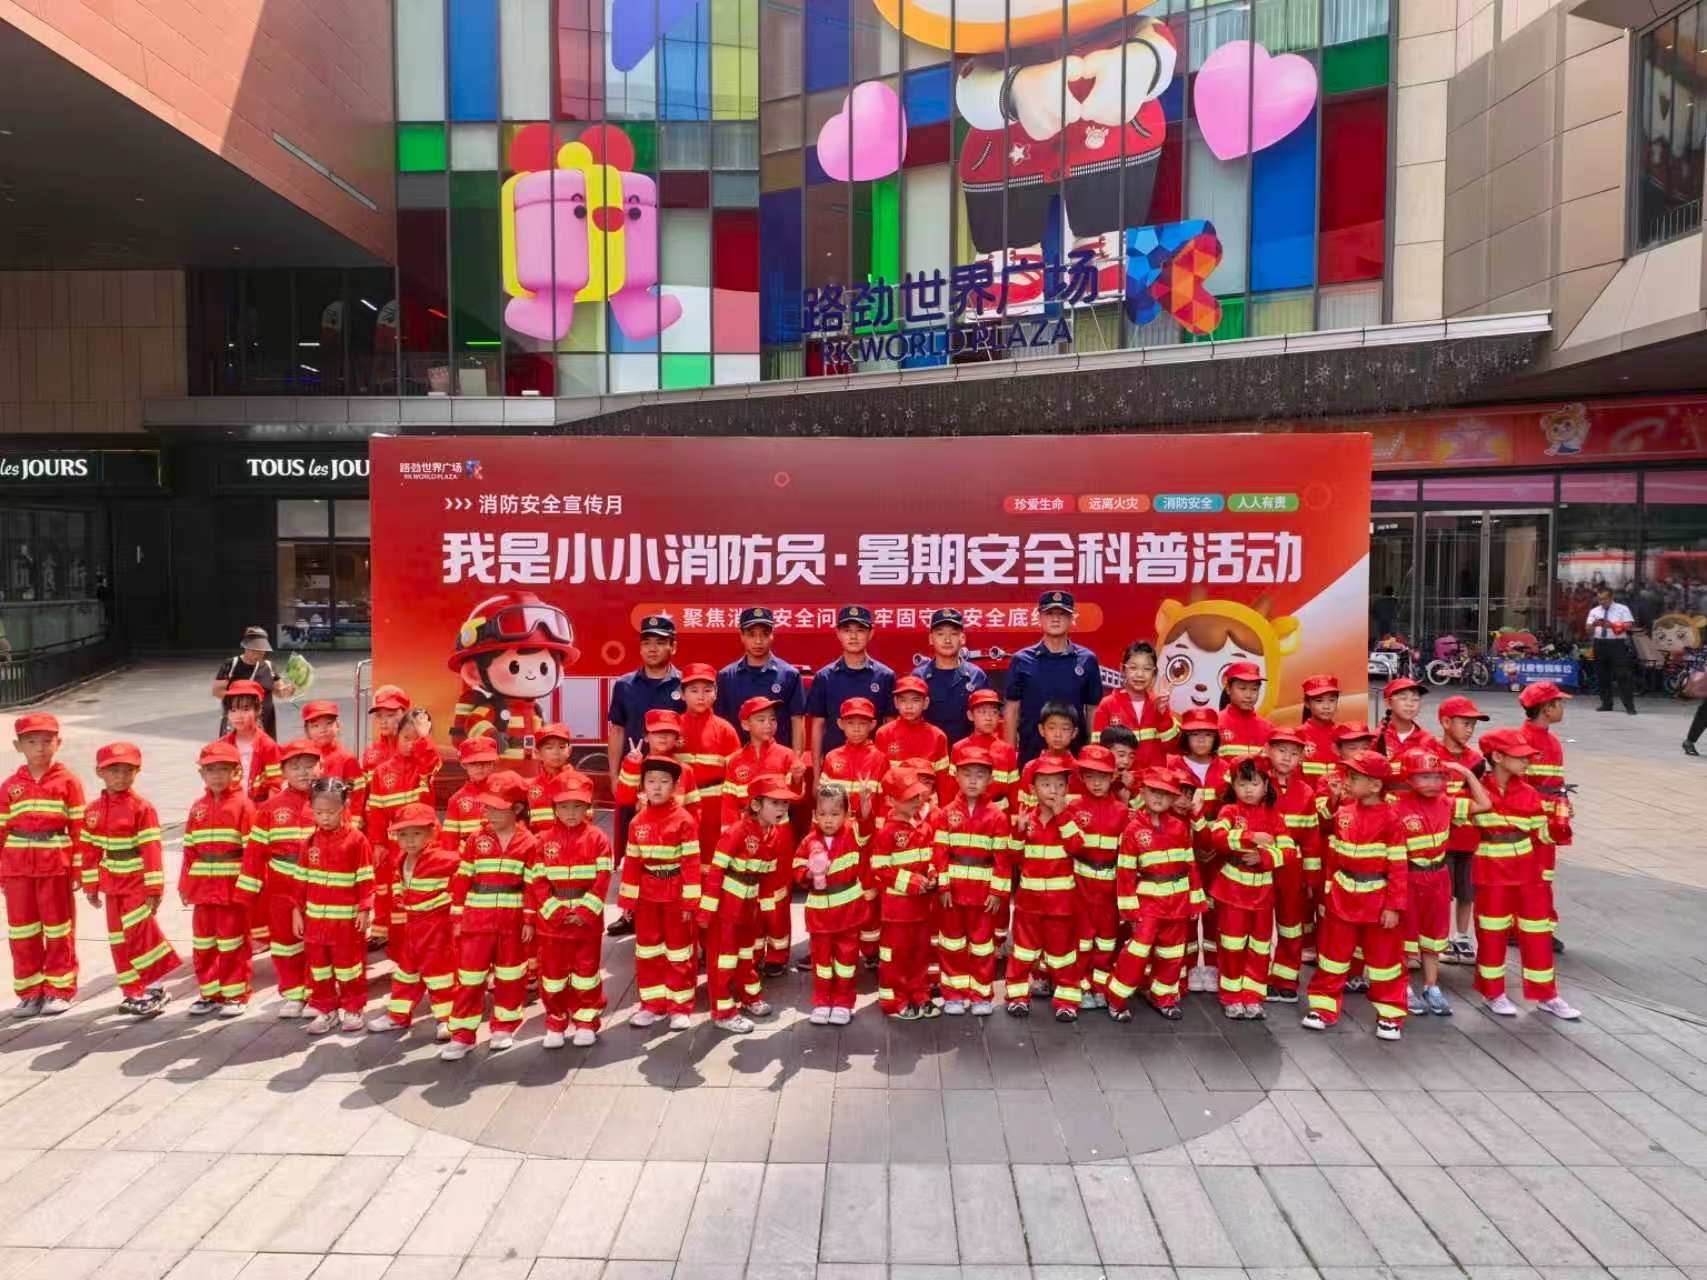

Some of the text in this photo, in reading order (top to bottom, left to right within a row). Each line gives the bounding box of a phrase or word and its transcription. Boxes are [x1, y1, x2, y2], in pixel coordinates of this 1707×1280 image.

[801, 250, 1099, 334] 路劲世界广场
[823, 318, 1073, 364] RK WORLD PLAZA
[21, 458, 88, 480] JOURS
[246, 458, 370, 481] TOUS les JOU
[399, 462, 462, 473] 路劲世界广场
[478, 494, 623, 516] 消防安全宣传月
[1014, 497, 1064, 511] 珍爱生命
[1088, 497, 1139, 511] 远离火灾
[1163, 496, 1213, 510] 消防安全
[1237, 496, 1287, 510] 人人有责
[442, 531, 1303, 586] 我是小小消防员·暑期安全科普活动
[682, 607, 1041, 629] 聚焦消安全问 牢固守安全底
